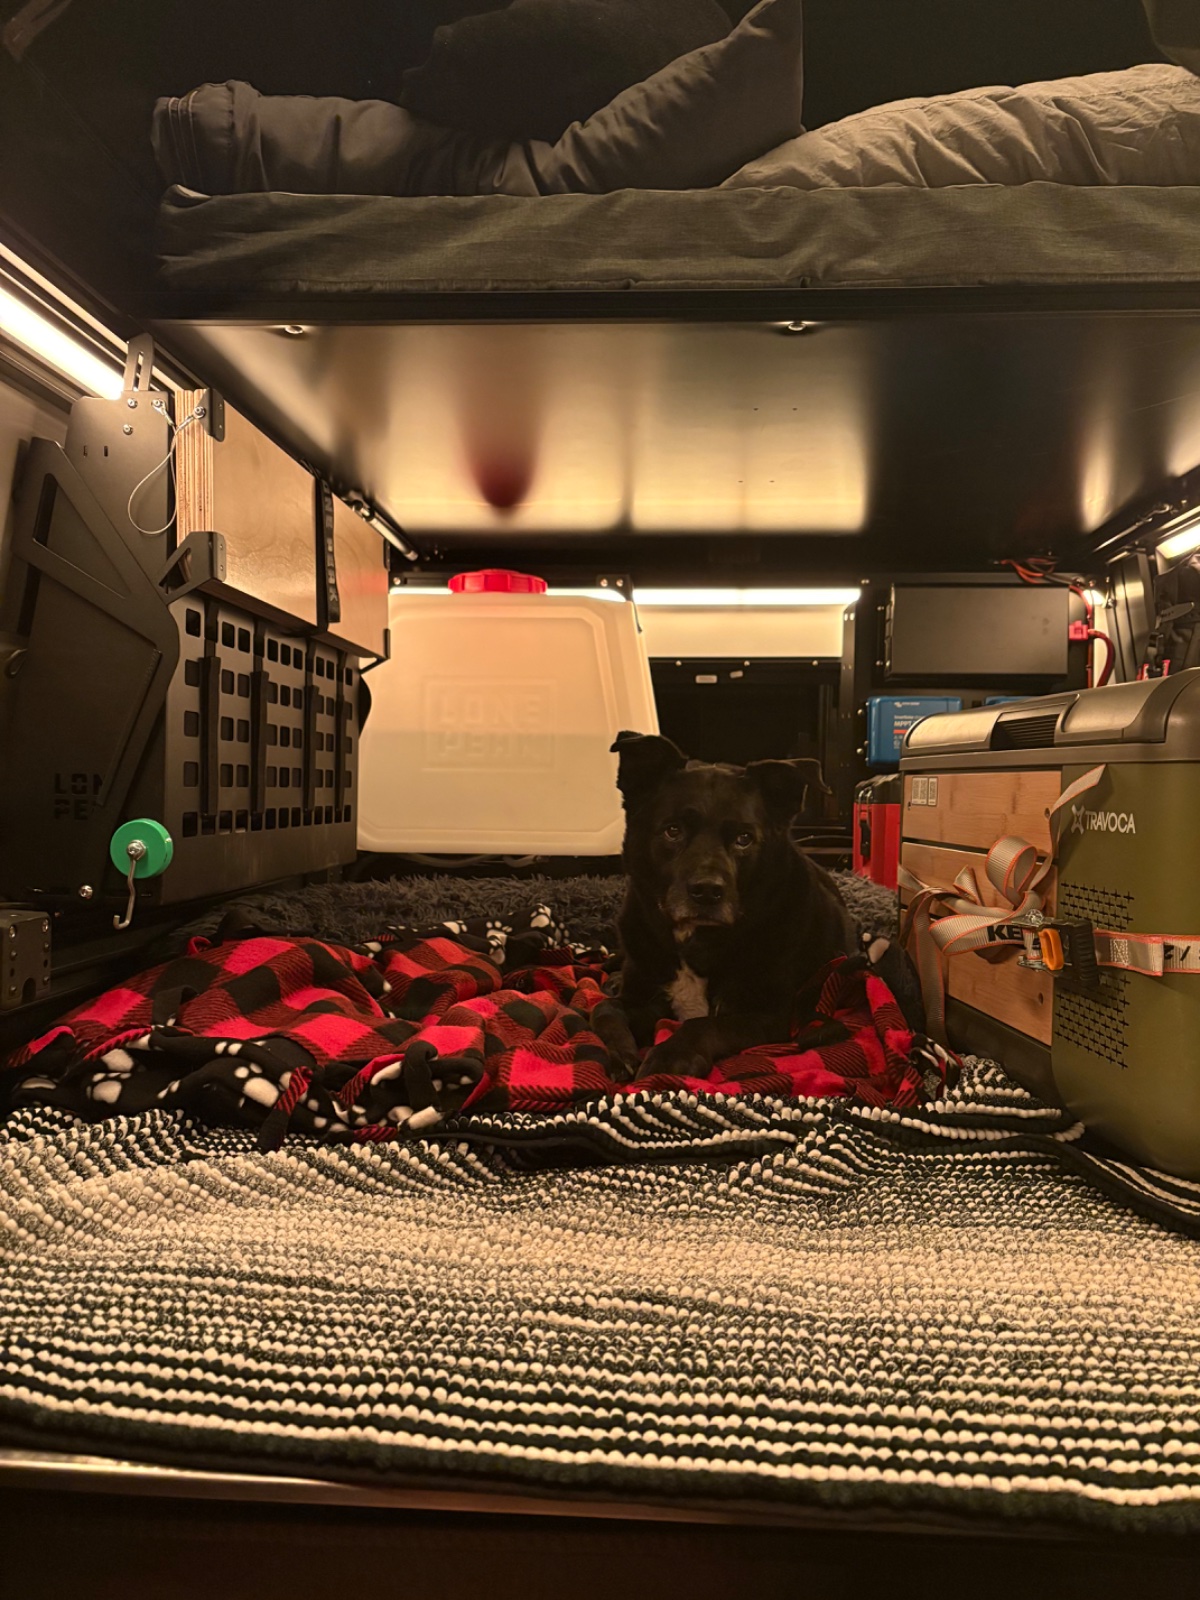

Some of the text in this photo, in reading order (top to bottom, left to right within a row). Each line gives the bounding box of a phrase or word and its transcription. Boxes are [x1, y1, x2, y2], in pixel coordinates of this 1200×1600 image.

[437, 693, 542, 725] LONE
[437, 728, 542, 758] PEAK
[54, 773, 103, 795] LON
[54, 799, 97, 820] PE
[1085, 810, 1136, 834] TRAVOCA
[986, 924, 1023, 942] KE
